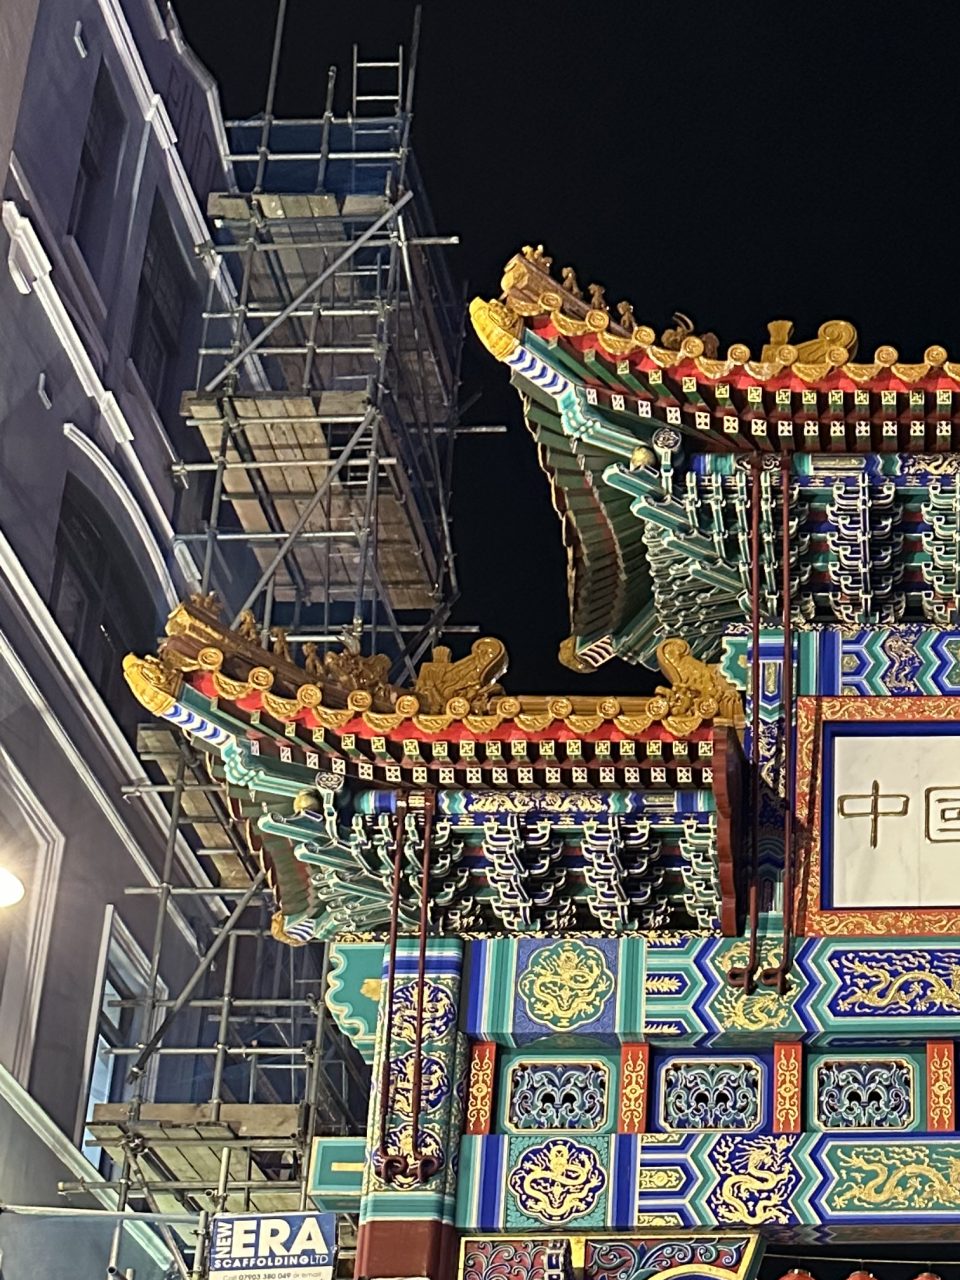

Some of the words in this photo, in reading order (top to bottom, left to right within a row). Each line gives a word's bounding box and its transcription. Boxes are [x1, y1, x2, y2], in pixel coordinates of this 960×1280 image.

[215, 1221, 232, 1259] NEW
[230, 1217, 329, 1258] ERA
[214, 1255, 309, 1269] SCAFFOLDING
[309, 1254, 329, 1265] LTD
[238, 1273, 261, 1280] 07903
